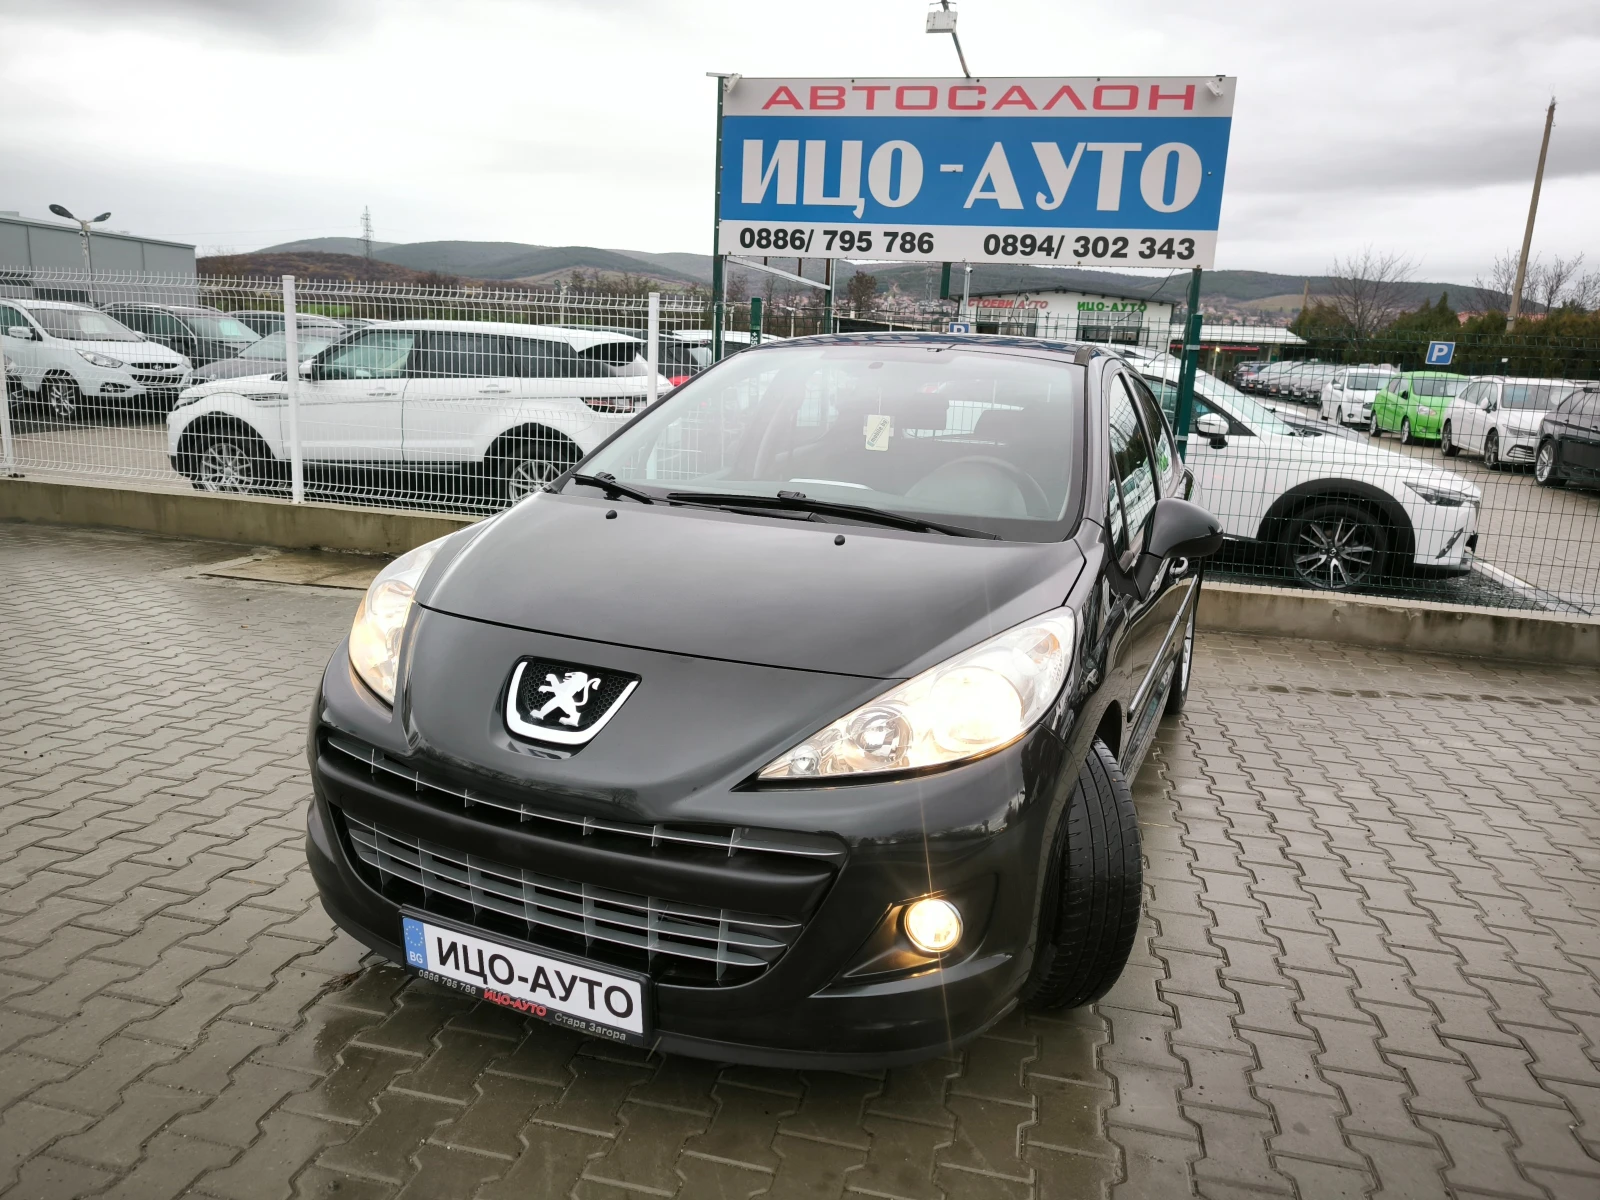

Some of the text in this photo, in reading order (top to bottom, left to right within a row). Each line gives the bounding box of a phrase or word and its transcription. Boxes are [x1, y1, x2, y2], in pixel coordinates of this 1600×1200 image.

[761, 85, 1196, 111] АВТОСАЛОН
[823, 229, 873, 252] 795
[883, 231, 935, 254] 786
[1072, 235, 1129, 259] 302
[1138, 236, 1196, 261] 343
[967, 298, 1014, 309] СТОЕВИ
[1077, 301, 1148, 313] ИЦО-АУТО
[1431, 344, 1449, 362] P
[409, 950, 424, 964] BG
[418, 969, 477, 995] 0886 795 786
[436, 936, 634, 1019] ИЦО-АУТО
[483, 987, 547, 1018] ИЦО-АУТО
[554, 1011, 627, 1041] Стара Загора
